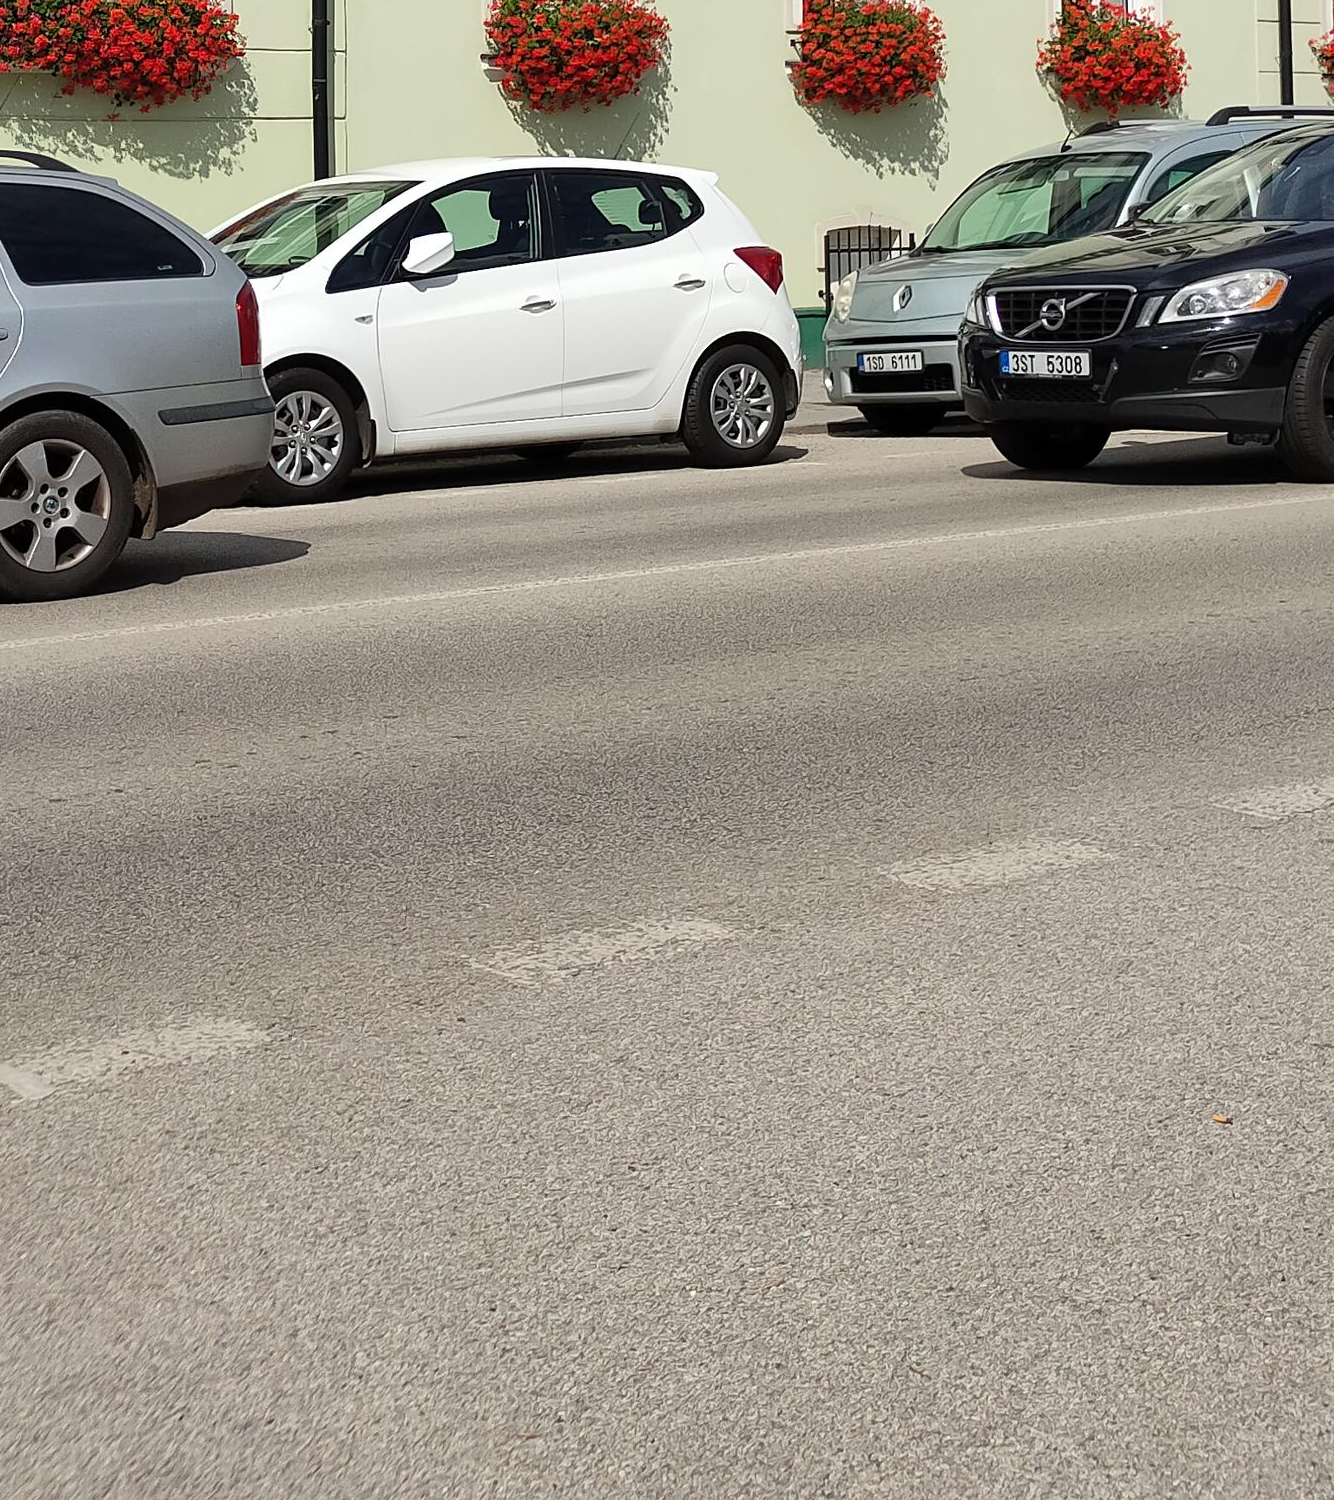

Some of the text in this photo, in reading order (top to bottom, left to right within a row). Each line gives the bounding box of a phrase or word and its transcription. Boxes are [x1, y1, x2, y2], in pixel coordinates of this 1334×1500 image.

[866, 355, 885, 371] 1SD
[891, 354, 917, 369] 6111
[1011, 355, 1083, 374] 3ST 5308
